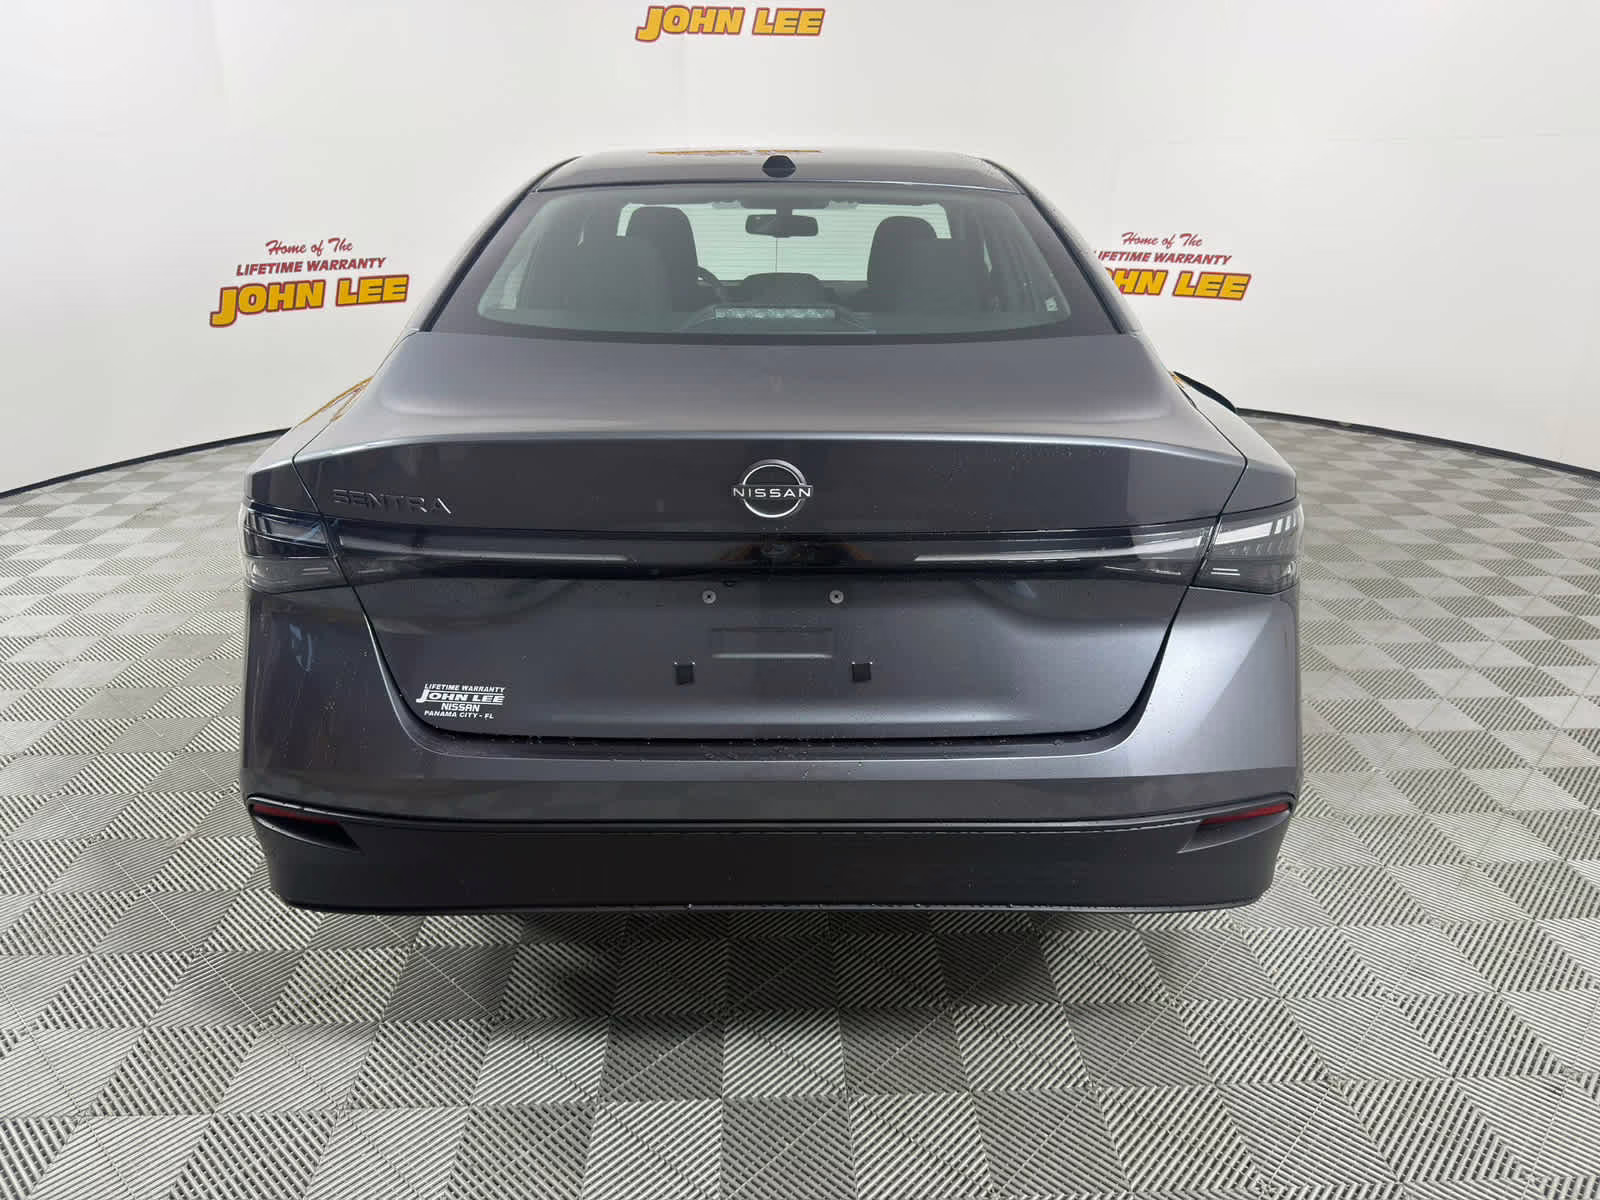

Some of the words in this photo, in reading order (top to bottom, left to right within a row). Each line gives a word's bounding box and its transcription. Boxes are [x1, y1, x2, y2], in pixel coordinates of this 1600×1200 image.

[635, 4, 745, 42] JOHN
[752, 7, 825, 36] LEE
[265, 239, 307, 255] Home
[310, 240, 324, 256] of
[328, 237, 352, 252] The
[1121, 231, 1159, 246] Home
[1161, 234, 1175, 249] of
[1179, 233, 1203, 247] The
[236, 261, 303, 276] LIFETIME
[306, 257, 386, 272] WARRANTY
[1093, 250, 1151, 262] IFETIME
[1152, 252, 1232, 265] WARRANTY
[1104, 267, 1168, 296] HN
[1172, 270, 1252, 301] LEE
[209, 279, 326, 328] JOHN
[335, 274, 409, 307] LEE
[332, 488, 452, 515] SENTRA
[732, 487, 812, 499] NISSAN
[415, 689, 468, 704] JOHN
[472, 693, 505, 704] LEE
[424, 683, 460, 691] LIFETIME
[461, 685, 505, 693] WARRANTY
[424, 710, 457, 718] PANAMA
[440, 702, 481, 713] NISSAN
